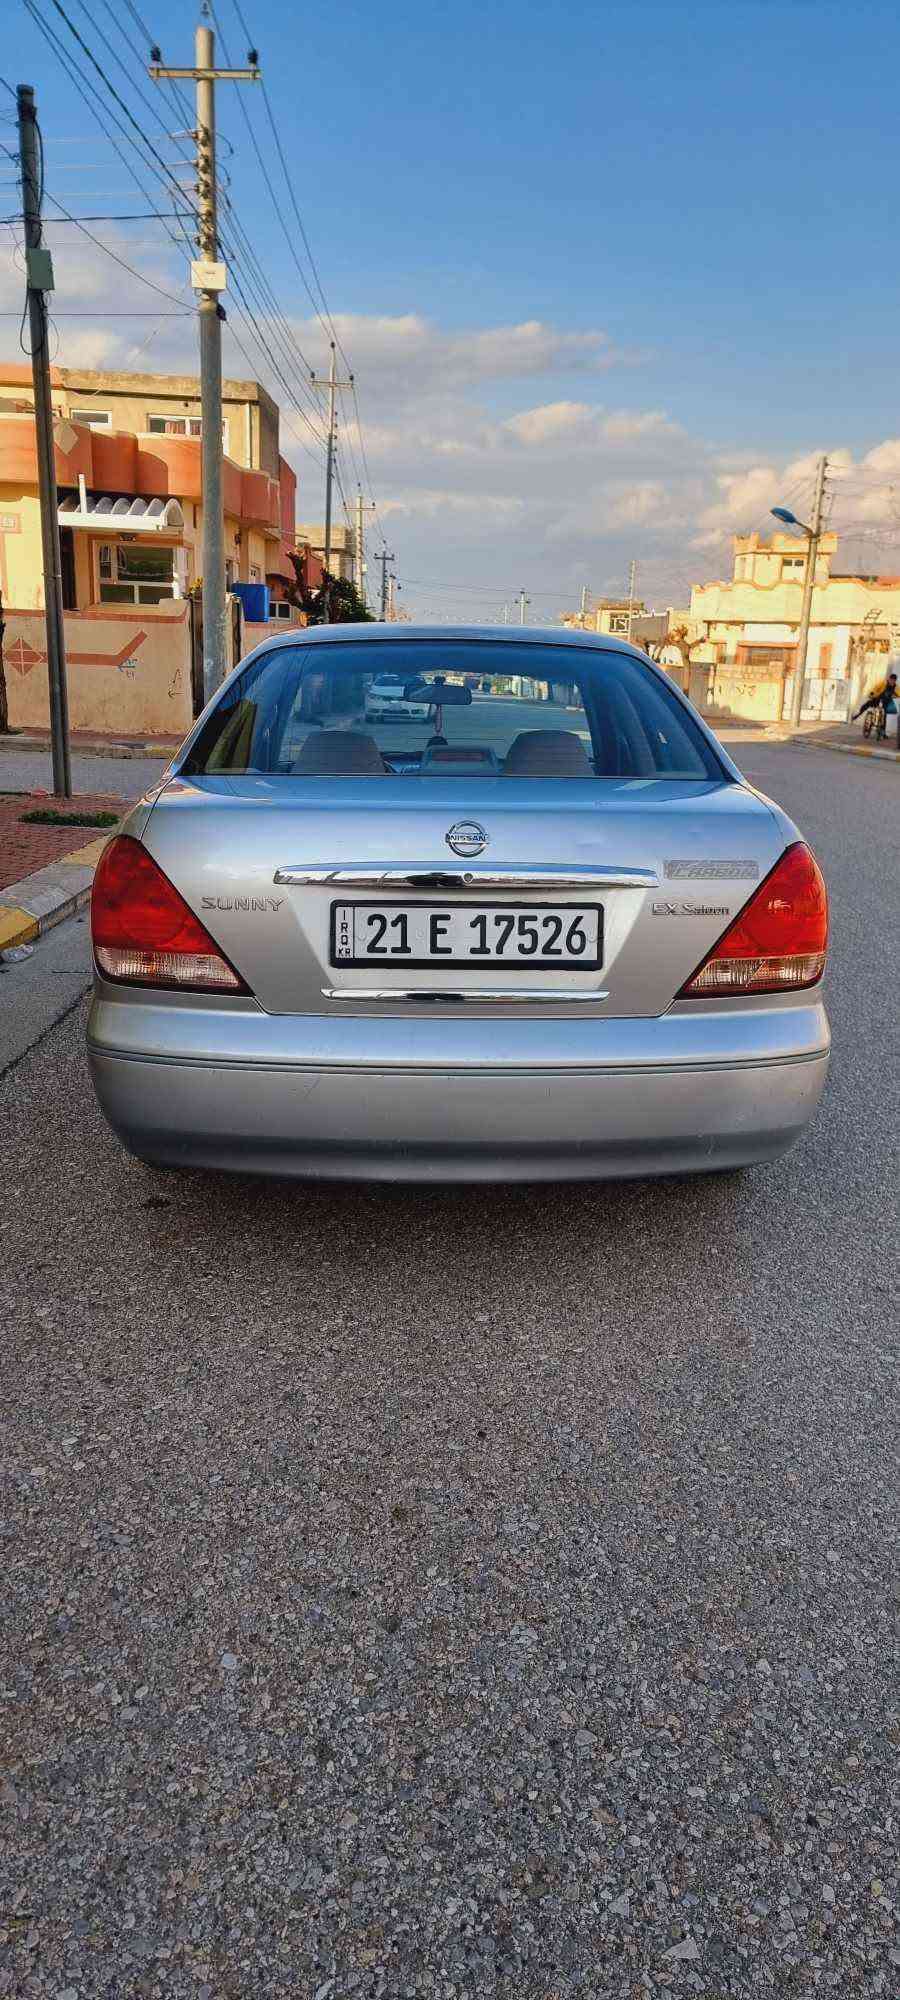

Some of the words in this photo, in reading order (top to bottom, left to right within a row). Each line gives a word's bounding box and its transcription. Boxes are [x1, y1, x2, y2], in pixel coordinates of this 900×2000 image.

[449, 833, 487, 842] NISSAN
[201, 896, 284, 911] SUNNY
[652, 903, 677, 915] EX
[367, 913, 411, 954] 21
[430, 913, 452, 954] E
[469, 913, 586, 955] 17526
